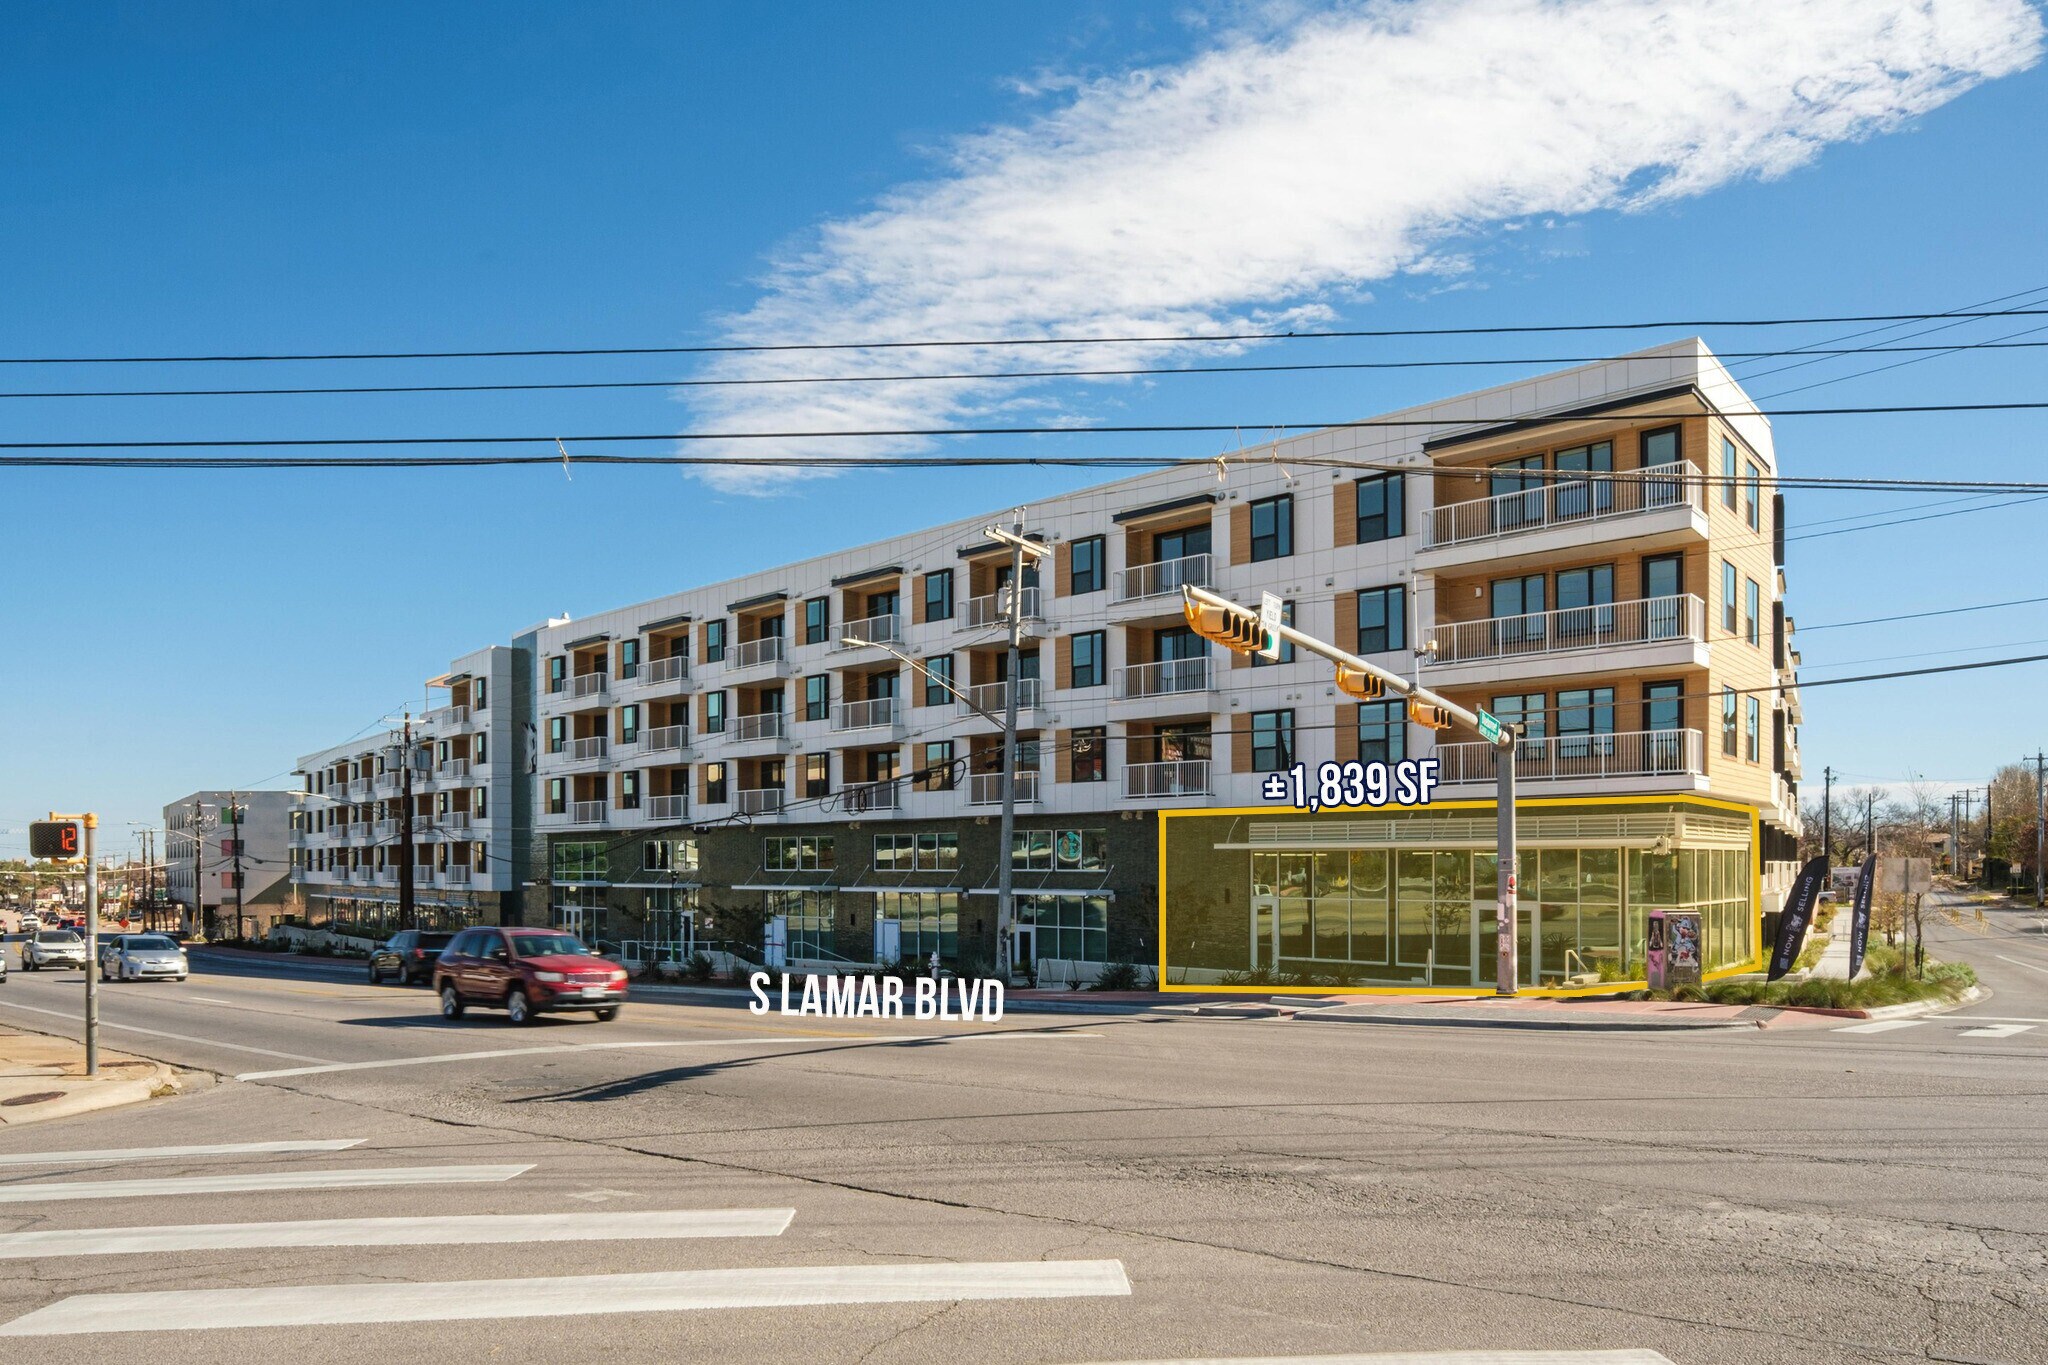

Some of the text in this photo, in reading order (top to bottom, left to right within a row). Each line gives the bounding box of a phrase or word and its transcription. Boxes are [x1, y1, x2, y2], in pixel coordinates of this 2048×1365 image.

[61, 827, 76, 851] 12
[1783, 876, 1814, 956] NOW SELLING
